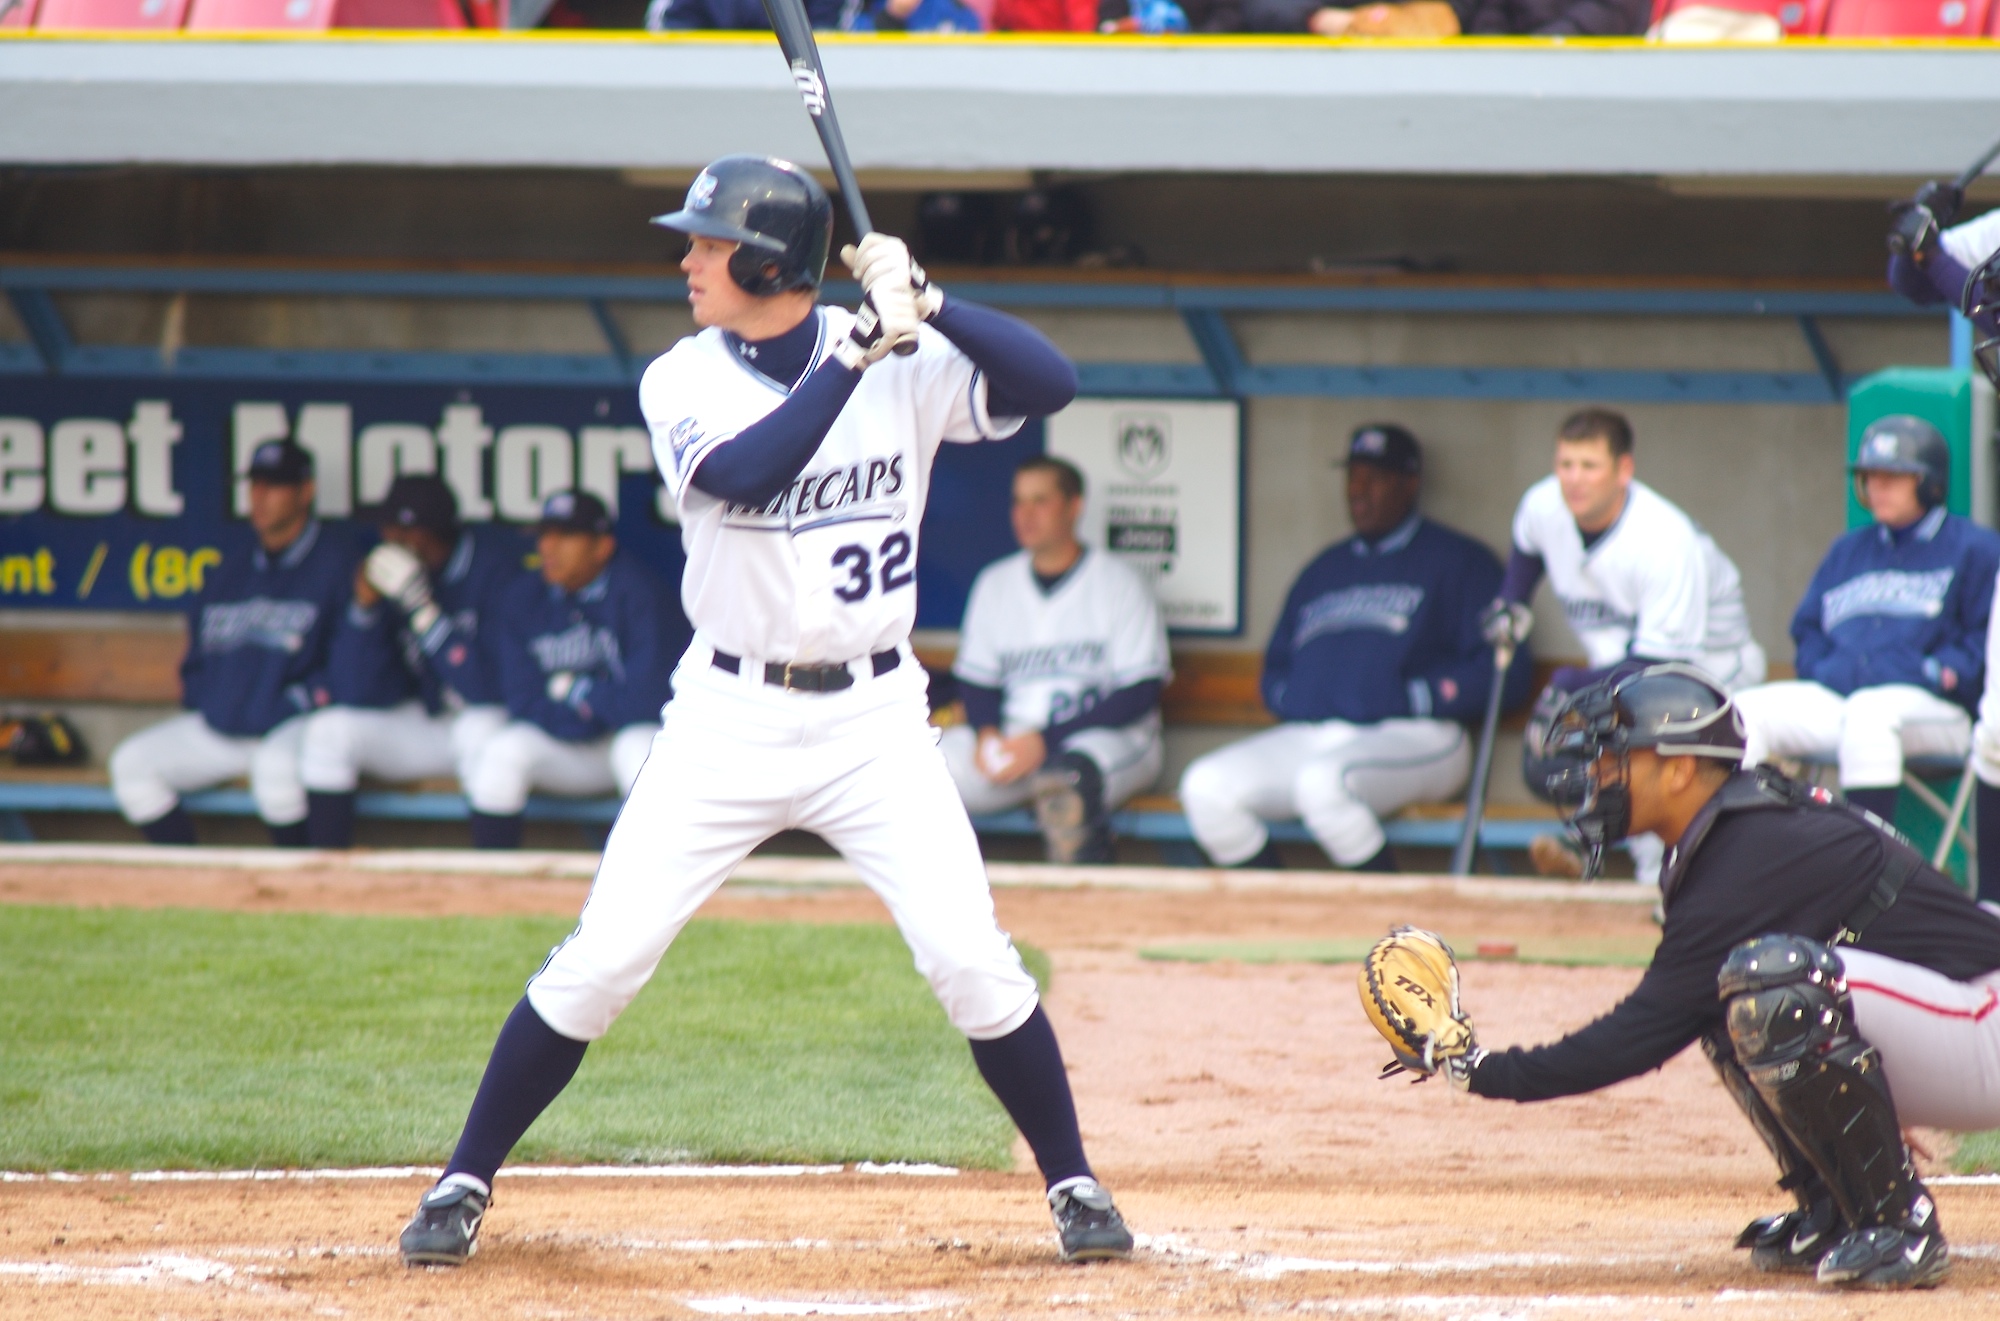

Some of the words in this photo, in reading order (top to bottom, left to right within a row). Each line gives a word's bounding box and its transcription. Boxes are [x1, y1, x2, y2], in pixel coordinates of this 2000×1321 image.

[231, 402, 681, 522] Motor
[831, 530, 916, 604] 32
[1394, 974, 1437, 1010] TPX
